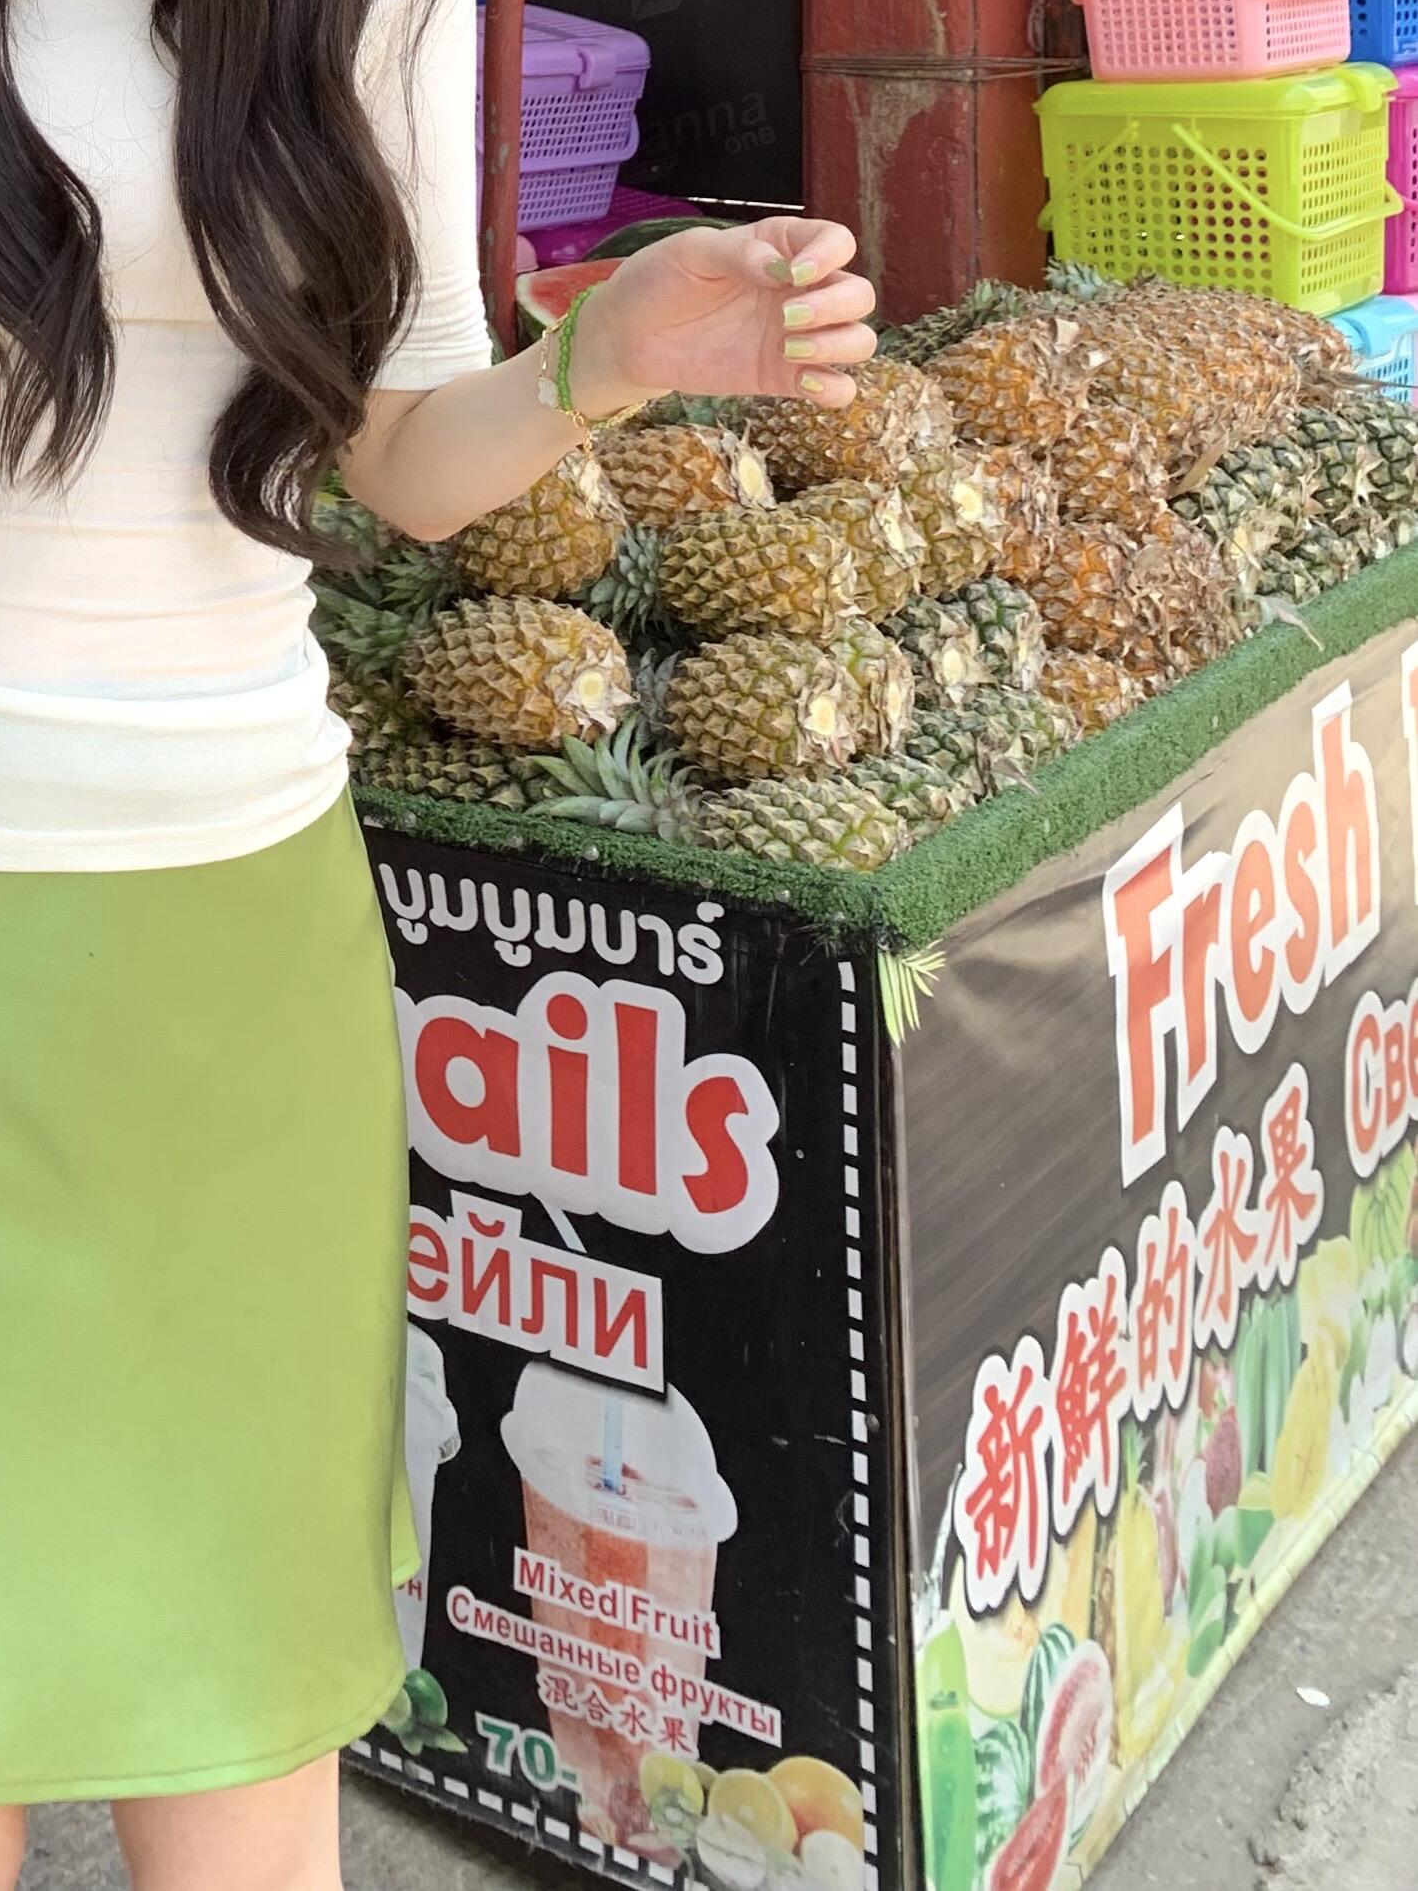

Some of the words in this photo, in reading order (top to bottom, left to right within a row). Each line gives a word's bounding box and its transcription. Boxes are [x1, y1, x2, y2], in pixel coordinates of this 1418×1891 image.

[1112, 710, 1372, 1148] Fresh
[414, 992, 750, 1216] ails
[964, 1083, 1318, 1582] 新鲜的水果
[451, 1592, 641, 1685] Смешанные
[650, 1663, 776, 1738] фрукты
[519, 1556, 618, 1620] Mixed
[632, 1594, 714, 1651] Fruit
[543, 1674, 693, 1754] 混合水果
